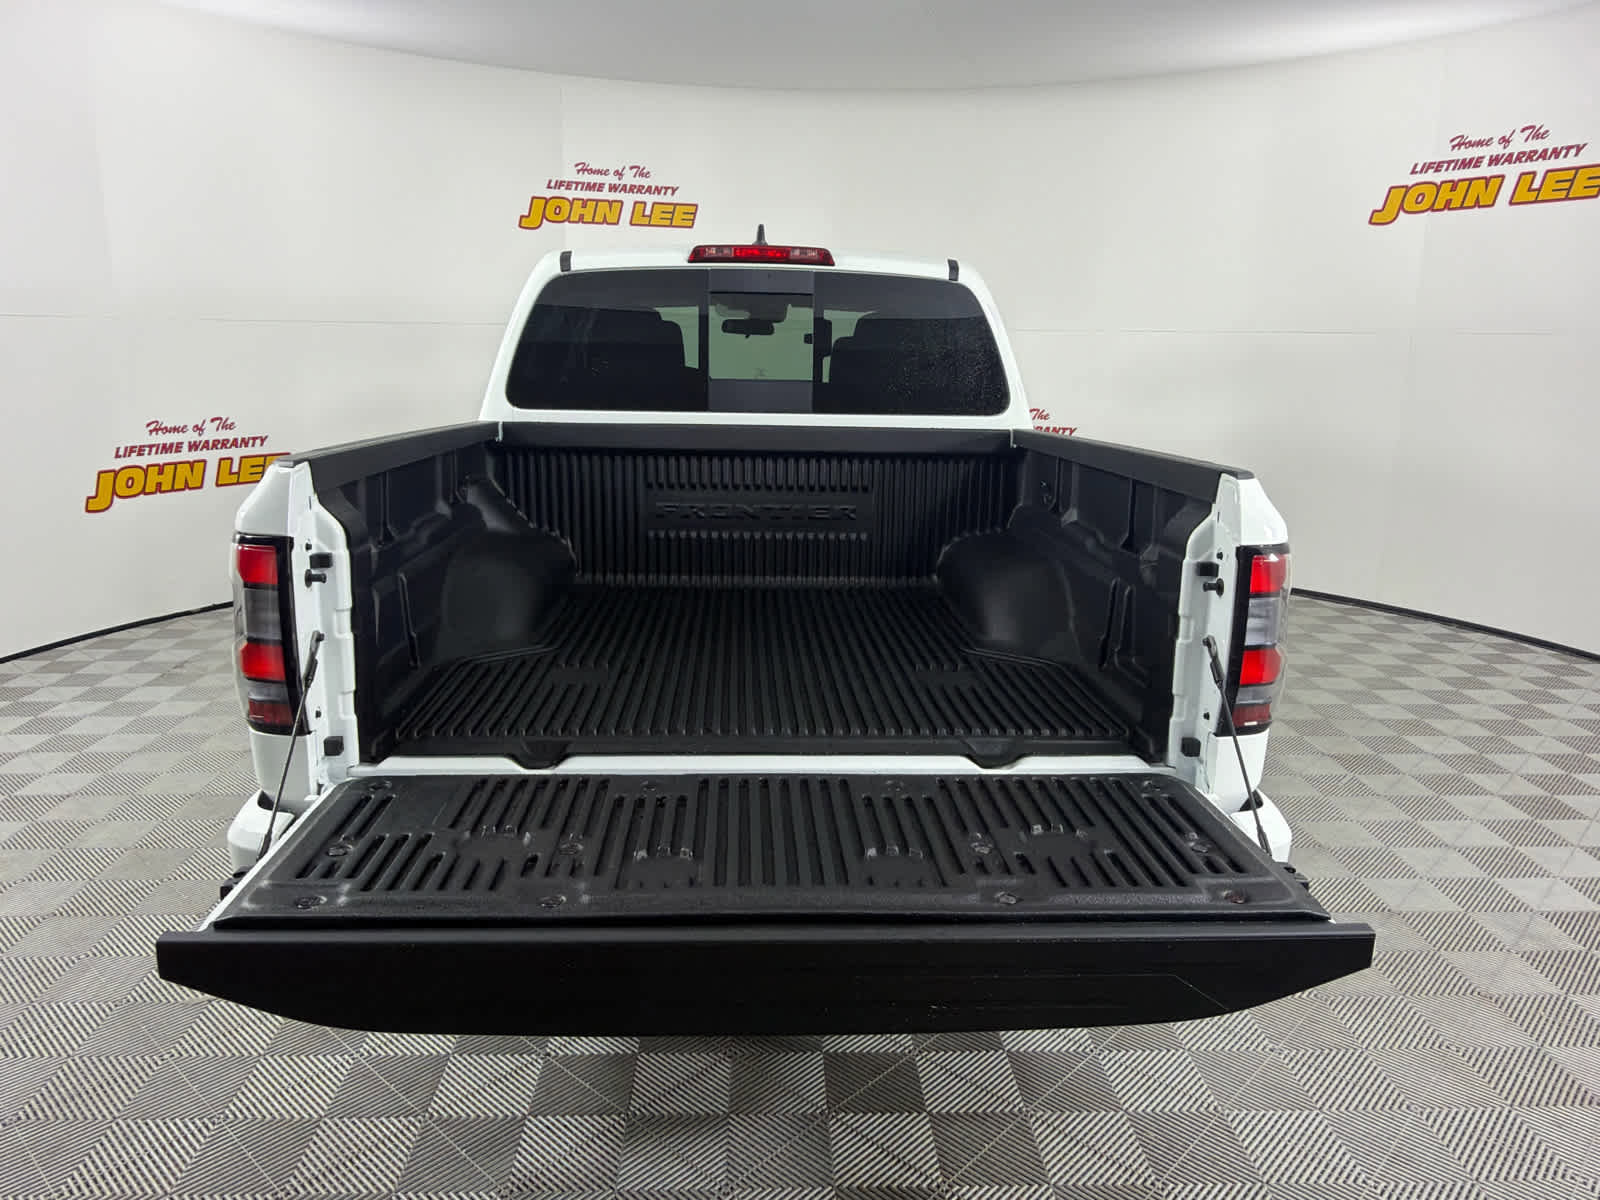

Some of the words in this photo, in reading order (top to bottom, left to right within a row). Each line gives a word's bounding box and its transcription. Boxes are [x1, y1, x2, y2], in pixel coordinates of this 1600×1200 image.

[1450, 135, 1494, 151] Home
[1497, 129, 1516, 149] of
[1520, 124, 1550, 142] The
[574, 162, 610, 177] Home
[613, 166, 626, 180] of
[629, 165, 651, 179] The
[1410, 156, 1484, 175] LIFETIME
[1487, 143, 1588, 167] WARRANTY
[546, 179, 605, 192] LIFETIME
[608, 182, 679, 196] WARRANTY
[1368, 174, 1505, 226] JOHN
[1509, 163, 1600, 206] LEE
[518, 196, 624, 230] JOHN
[629, 201, 699, 229] LEE
[1029, 408, 1049, 420] The
[145, 420, 188, 436] Home
[192, 420, 206, 436] of
[210, 417, 237, 432] The
[114, 441, 183, 459] LIFETIME
[188, 435, 268, 452] WARRANTY
[85, 459, 207, 513] JOHN
[656, 502, 857, 520] FRONTIER
